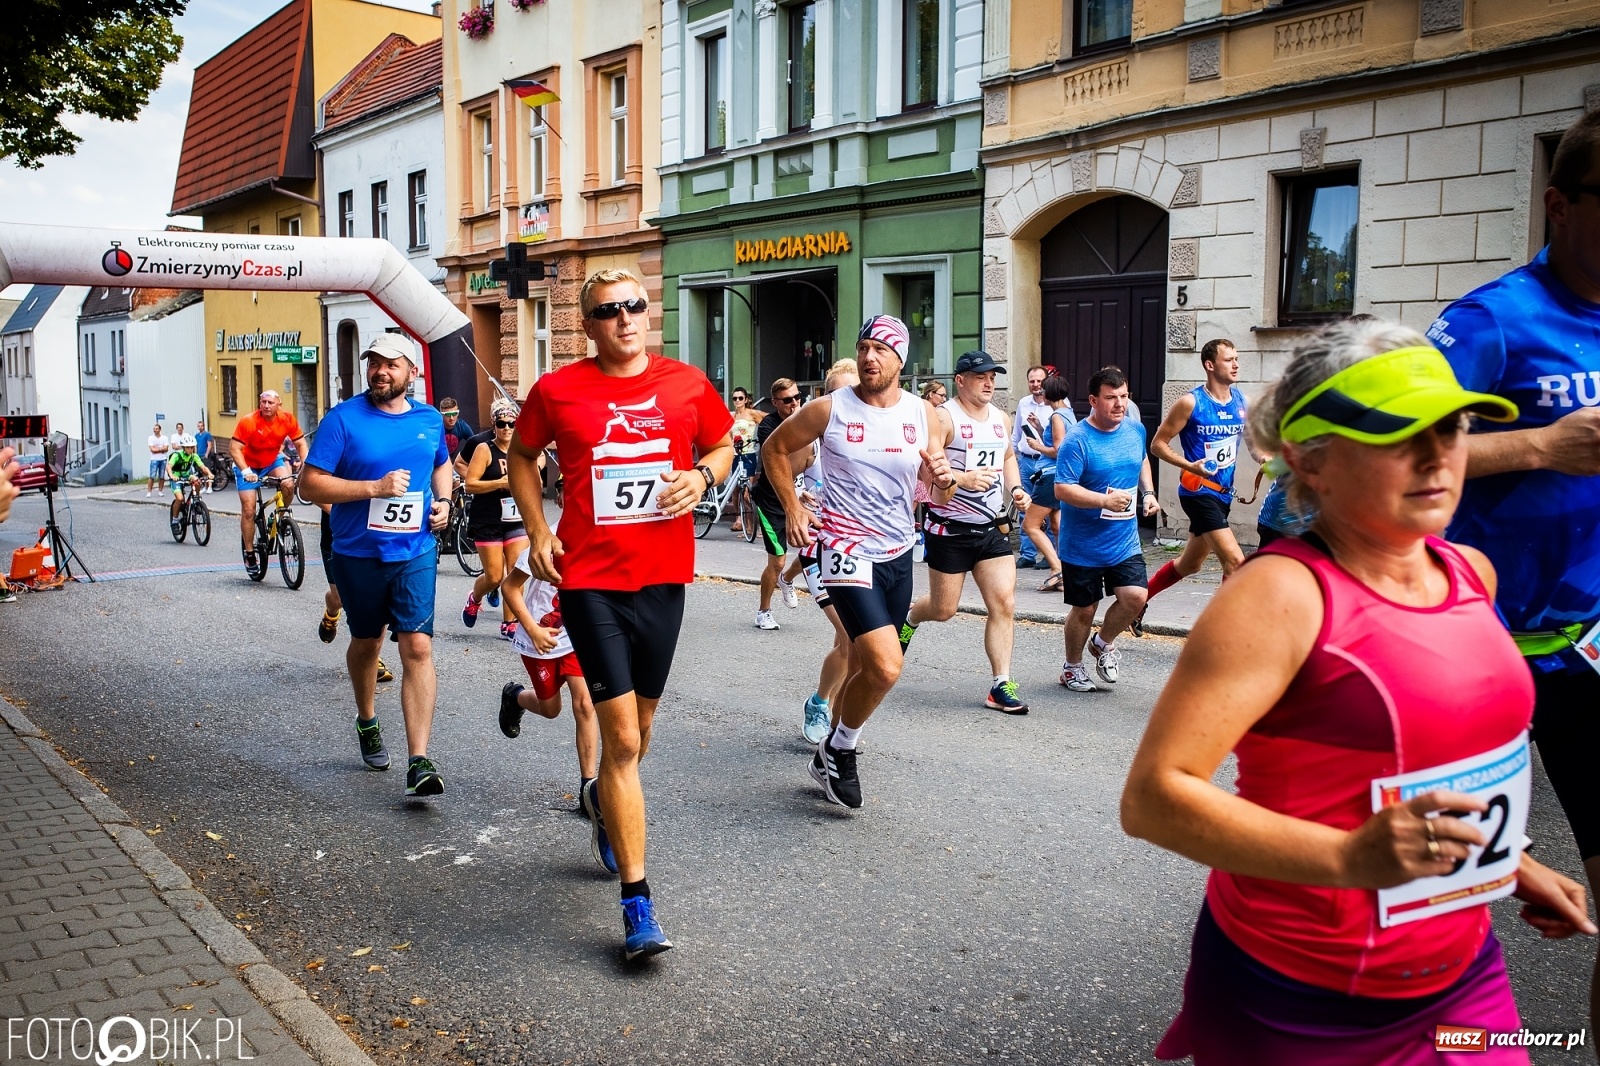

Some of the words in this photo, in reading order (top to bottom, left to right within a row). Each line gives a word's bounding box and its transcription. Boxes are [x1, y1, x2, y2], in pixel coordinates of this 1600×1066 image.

[138, 237, 218, 251] Elektroniczny
[222, 241, 260, 251] pomiar
[264, 243, 295, 251] czasu
[735, 231, 851, 265] KWIACIARNIA
[137, 256, 303, 280] ZmierzymyCzas.pl
[1177, 285, 1188, 306] 5
[227, 334, 246, 351] BANK
[976, 450, 995, 467] 21
[1216, 445, 1232, 462] 64
[609, 469, 624, 477] BIEG
[614, 480, 655, 510] 57
[383, 503, 413, 524] 55
[830, 553, 858, 575] 35
